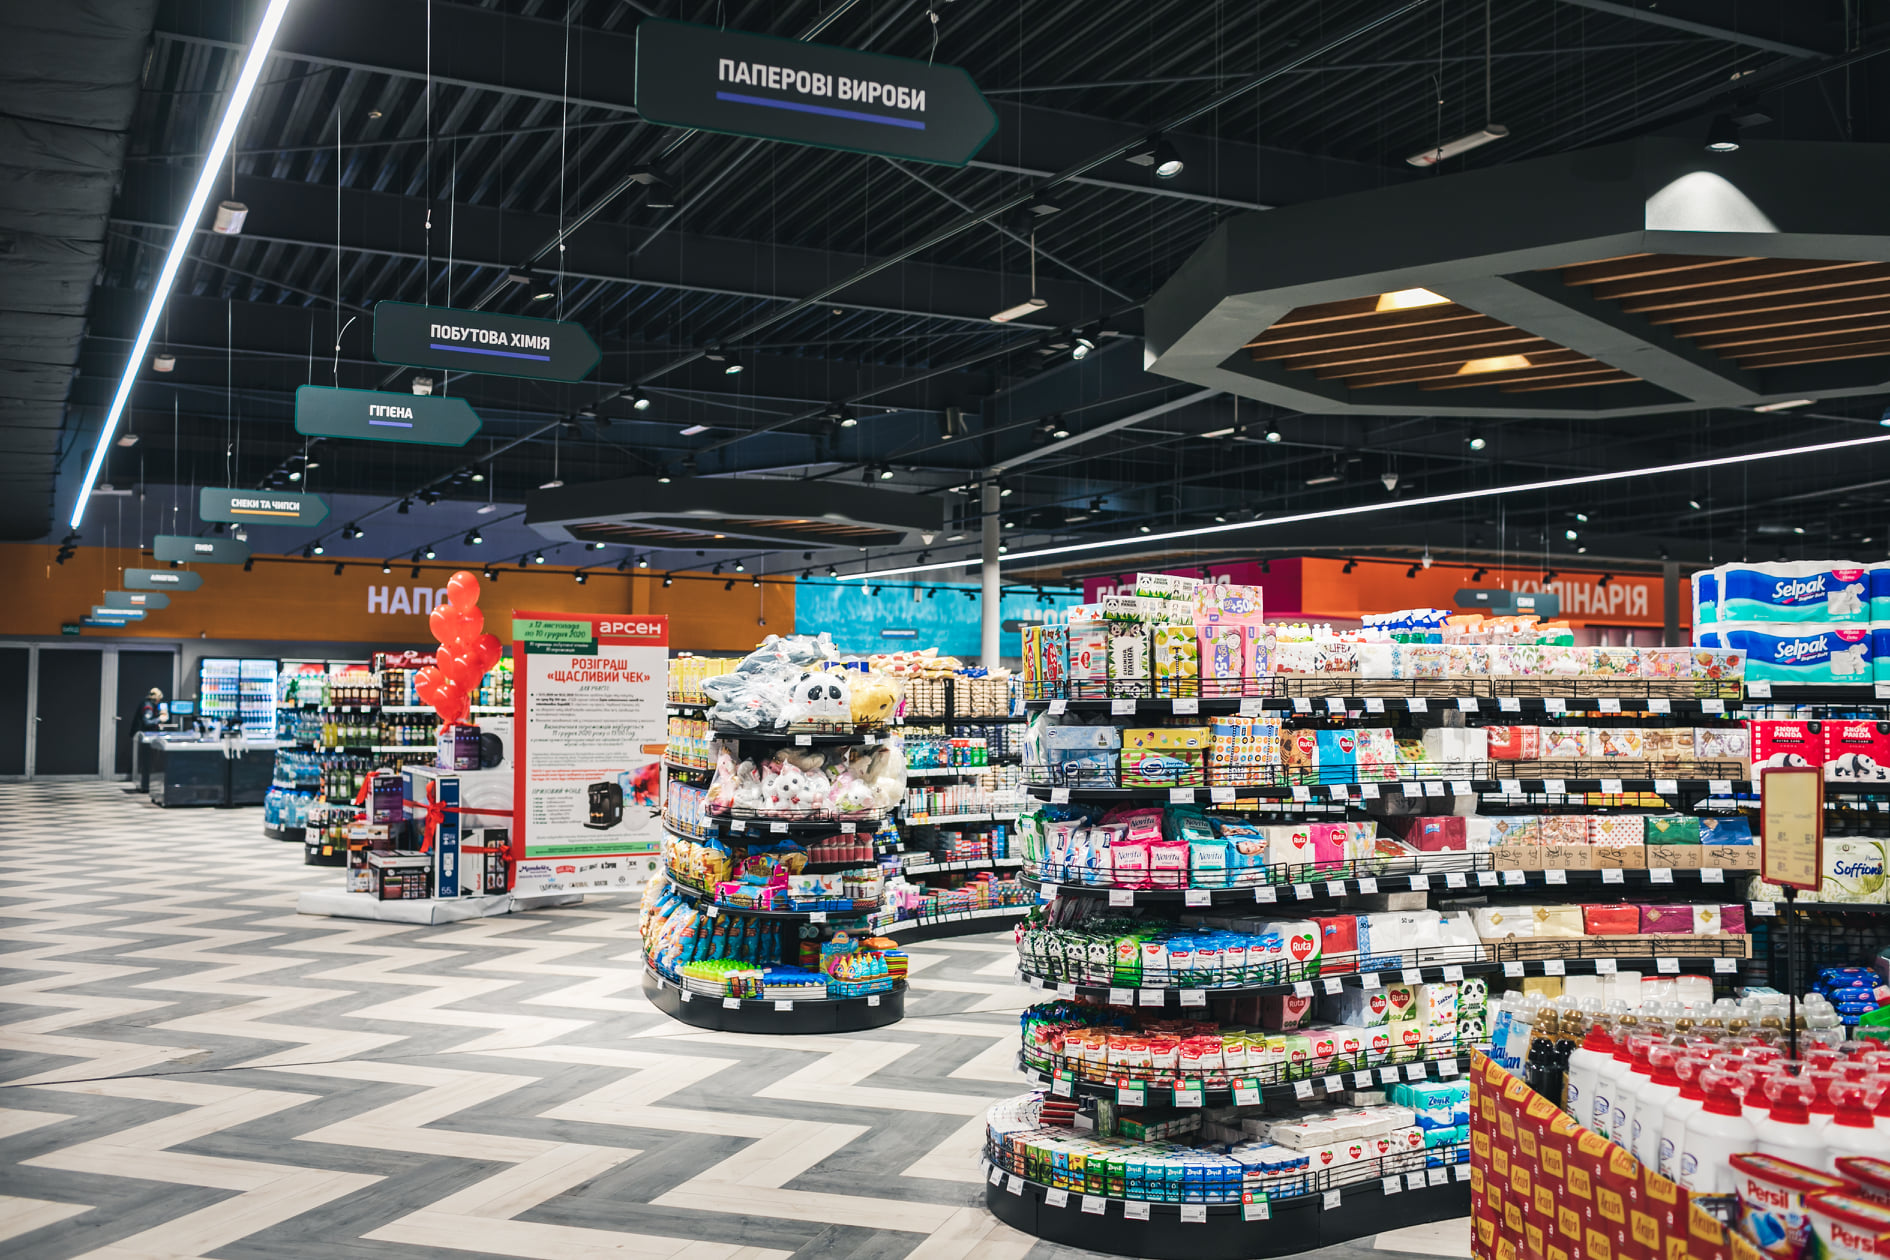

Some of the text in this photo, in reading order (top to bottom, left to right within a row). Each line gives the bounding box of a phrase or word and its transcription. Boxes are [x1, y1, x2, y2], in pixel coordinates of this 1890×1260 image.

[719, 58, 926, 112] ПАПЕРОВІ ВИРОБИ
[430, 324, 550, 351] ПОБУТОВА ХІМІЯ
[369, 404, 413, 420] ГІГІЄНА
[231, 499, 300, 511] СНЕКИ ТА ЧИПСИ
[1772, 575, 1826, 600] Selpak
[1329, 643, 1347, 653] LIFE
[1774, 635, 1829, 660] Selpak
[571, 658, 628, 671] РОЗІГРАШ
[622, 672, 651, 683] ЧЕК»
[1842, 731, 1872, 739] PANDA
[1130, 817, 1155, 828] Novita
[1185, 818, 1209, 827] Novita
[1117, 851, 1142, 860] Novita
[1155, 852, 1180, 861] Novita
[1199, 851, 1223, 860] Novita
[1293, 942, 1312, 951] Ruta
[1392, 994, 1409, 1002] Ruta
[1289, 1000, 1304, 1008] Ruta
[1372, 1000, 1386, 1008] Ruta
[1404, 1034, 1420, 1042] Ruta
[1318, 1045, 1332, 1053] Ruta
[1747, 1179, 1789, 1209] Persil
